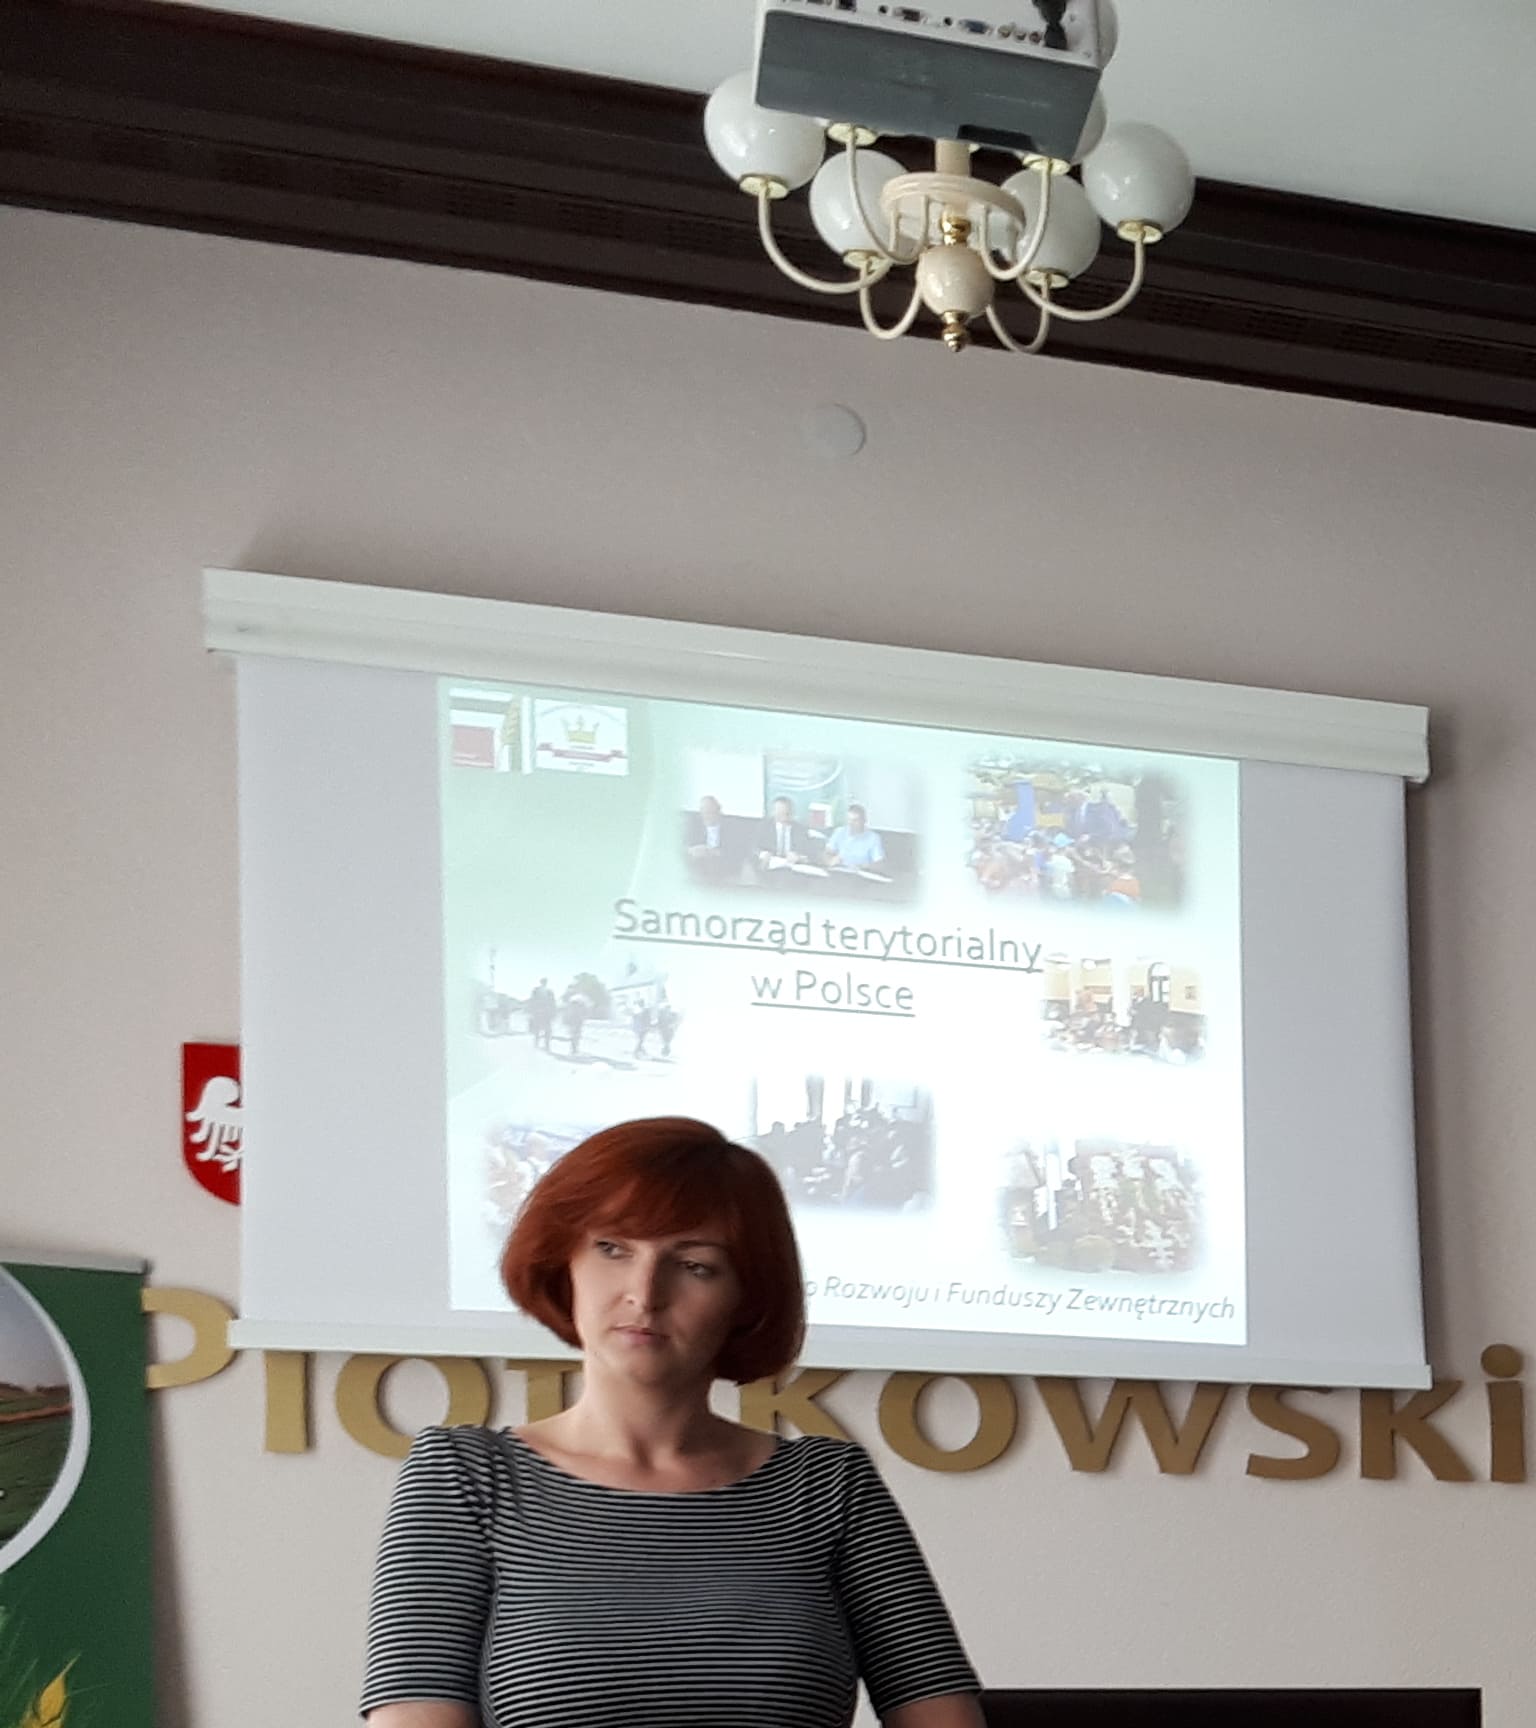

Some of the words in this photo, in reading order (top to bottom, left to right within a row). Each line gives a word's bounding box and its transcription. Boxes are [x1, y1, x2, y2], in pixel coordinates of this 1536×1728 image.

[613, 898, 811, 954] Samorząd
[822, 919, 1042, 973] terytorialny
[751, 975, 782, 999] w
[796, 969, 913, 1010] Polsce
[825, 1275, 926, 1308] Rozwoju
[947, 1282, 1062, 1315] Funduszy
[1066, 1288, 1236, 1323] Zewnętrznych
